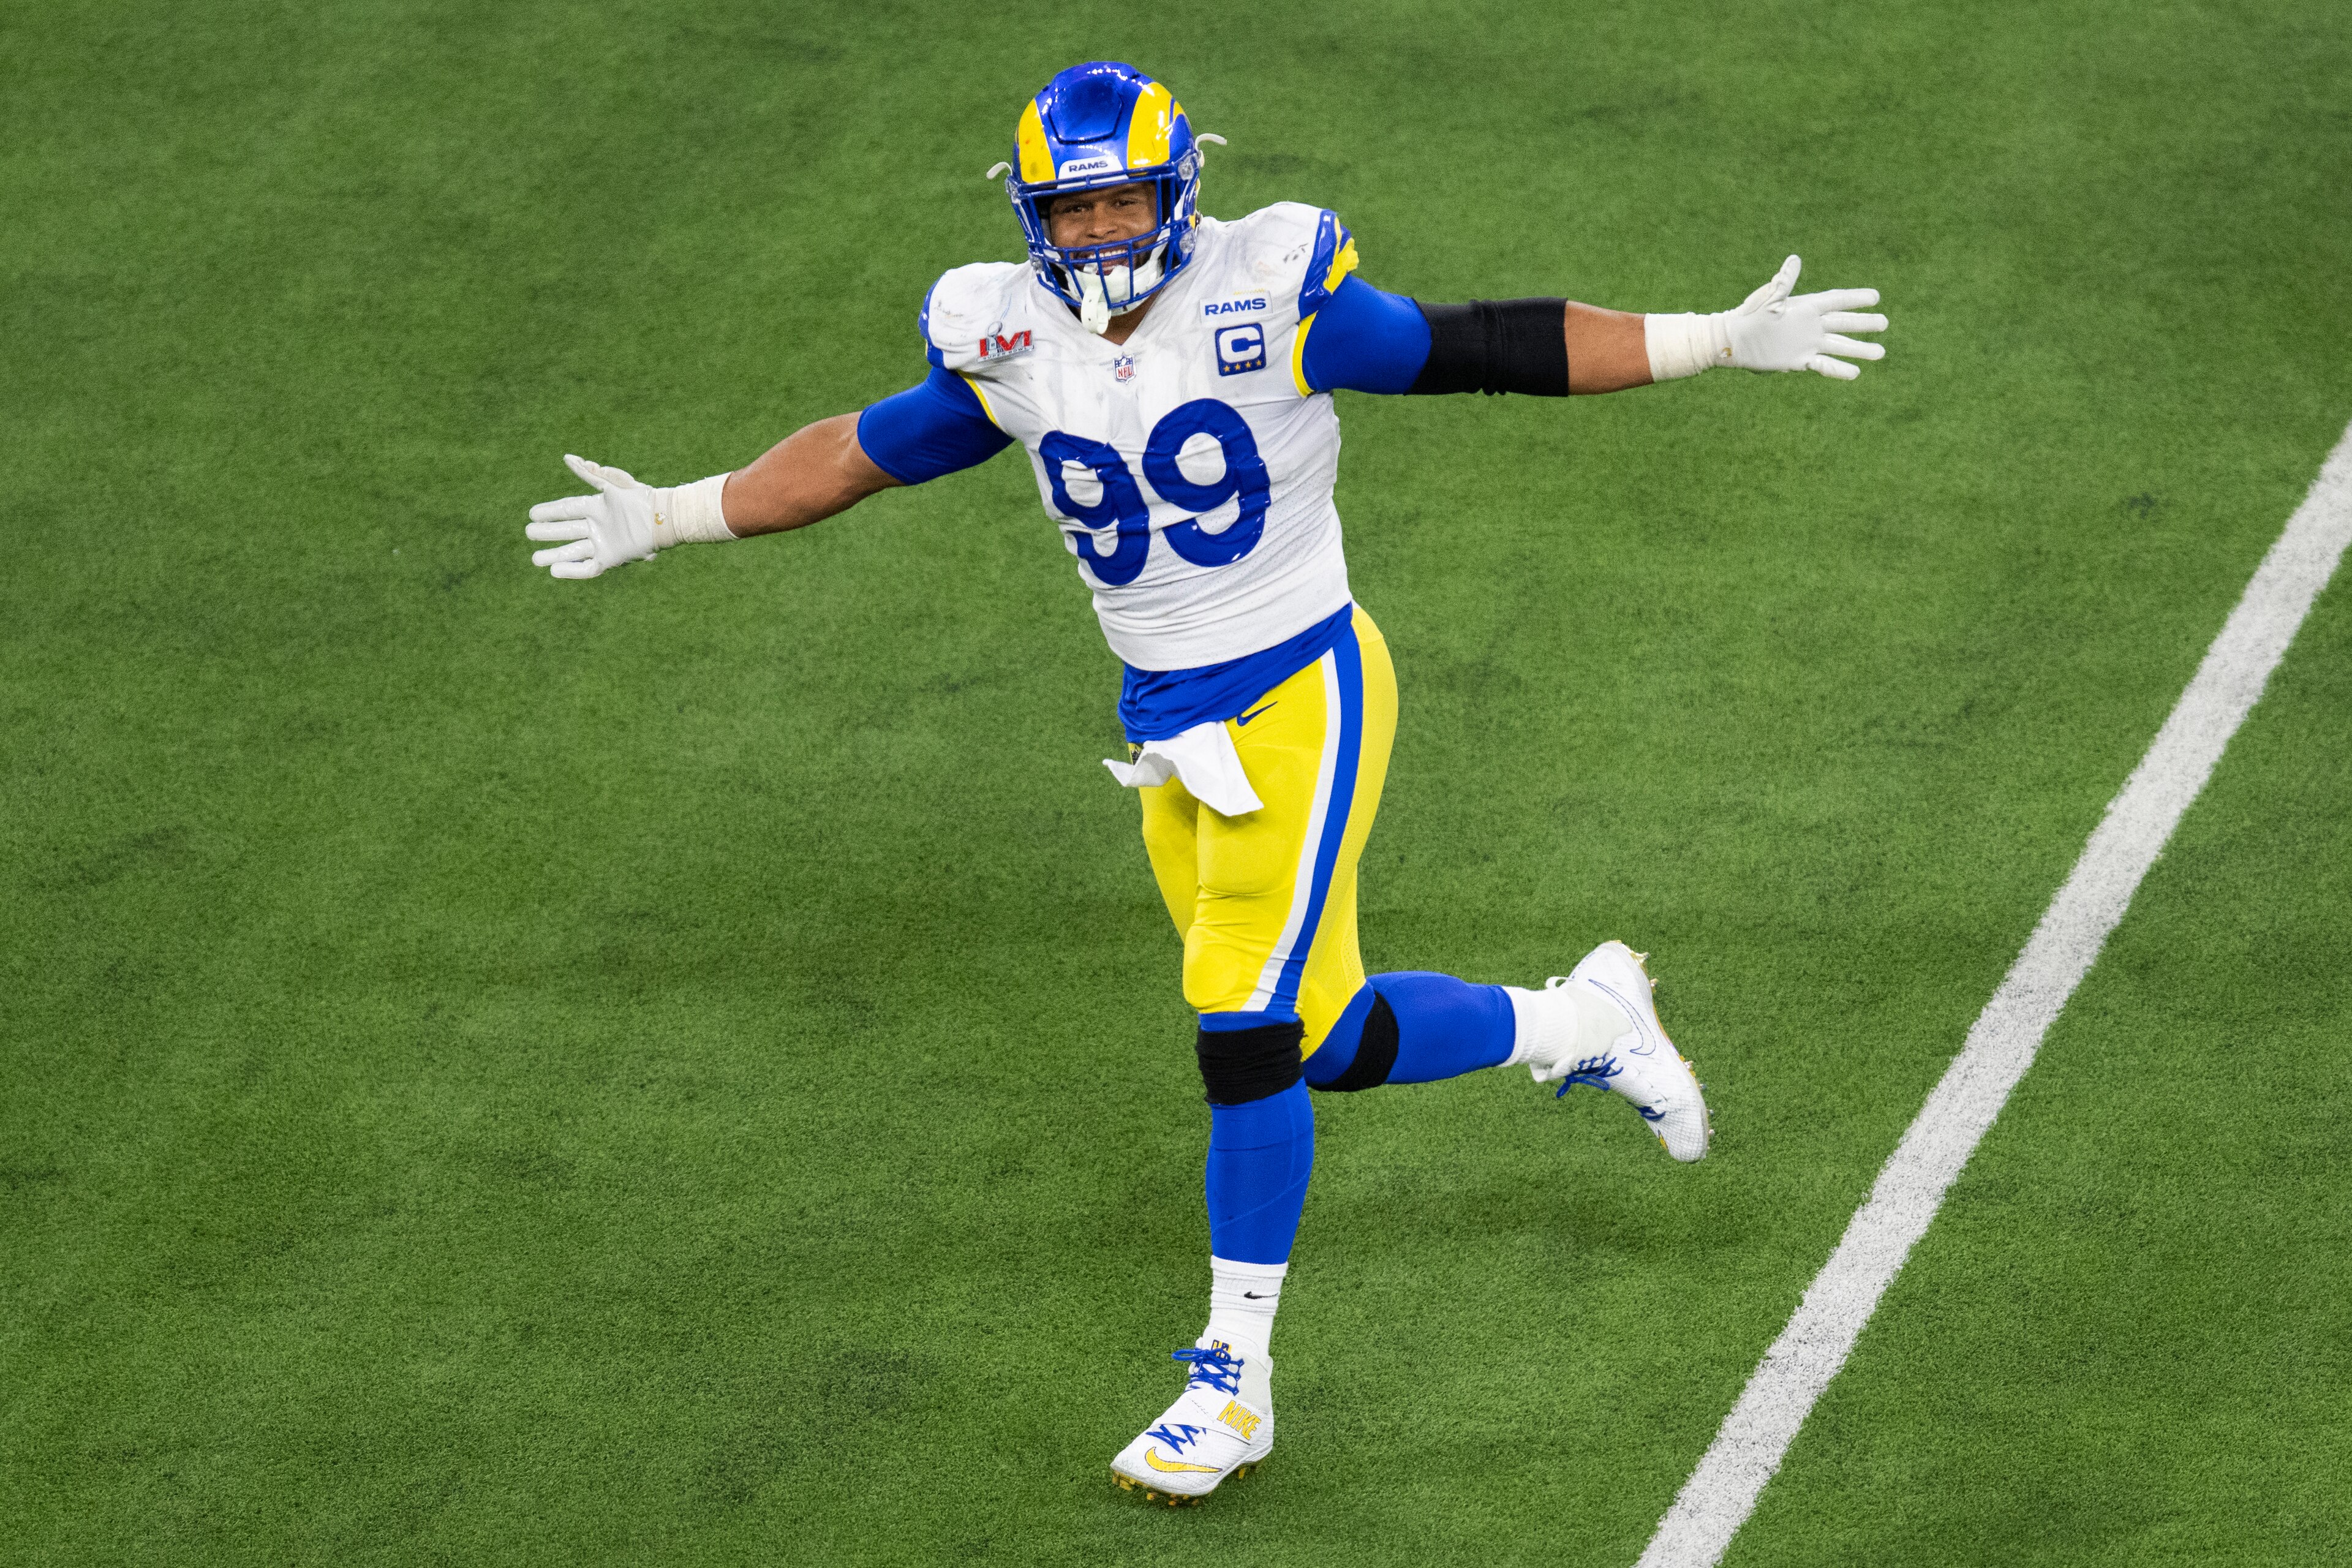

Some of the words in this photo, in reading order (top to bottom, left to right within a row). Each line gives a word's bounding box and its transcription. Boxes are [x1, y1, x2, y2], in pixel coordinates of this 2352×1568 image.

[1069, 160, 1108, 172] RAMS
[1205, 298, 1266, 315] RAMS
[979, 330, 1031, 357] LVI
[1219, 326, 1262, 364] C
[1118, 366, 1133, 378] NFL
[1039, 398, 1271, 586] 99
[1216, 1400, 1262, 1441] NIKE
